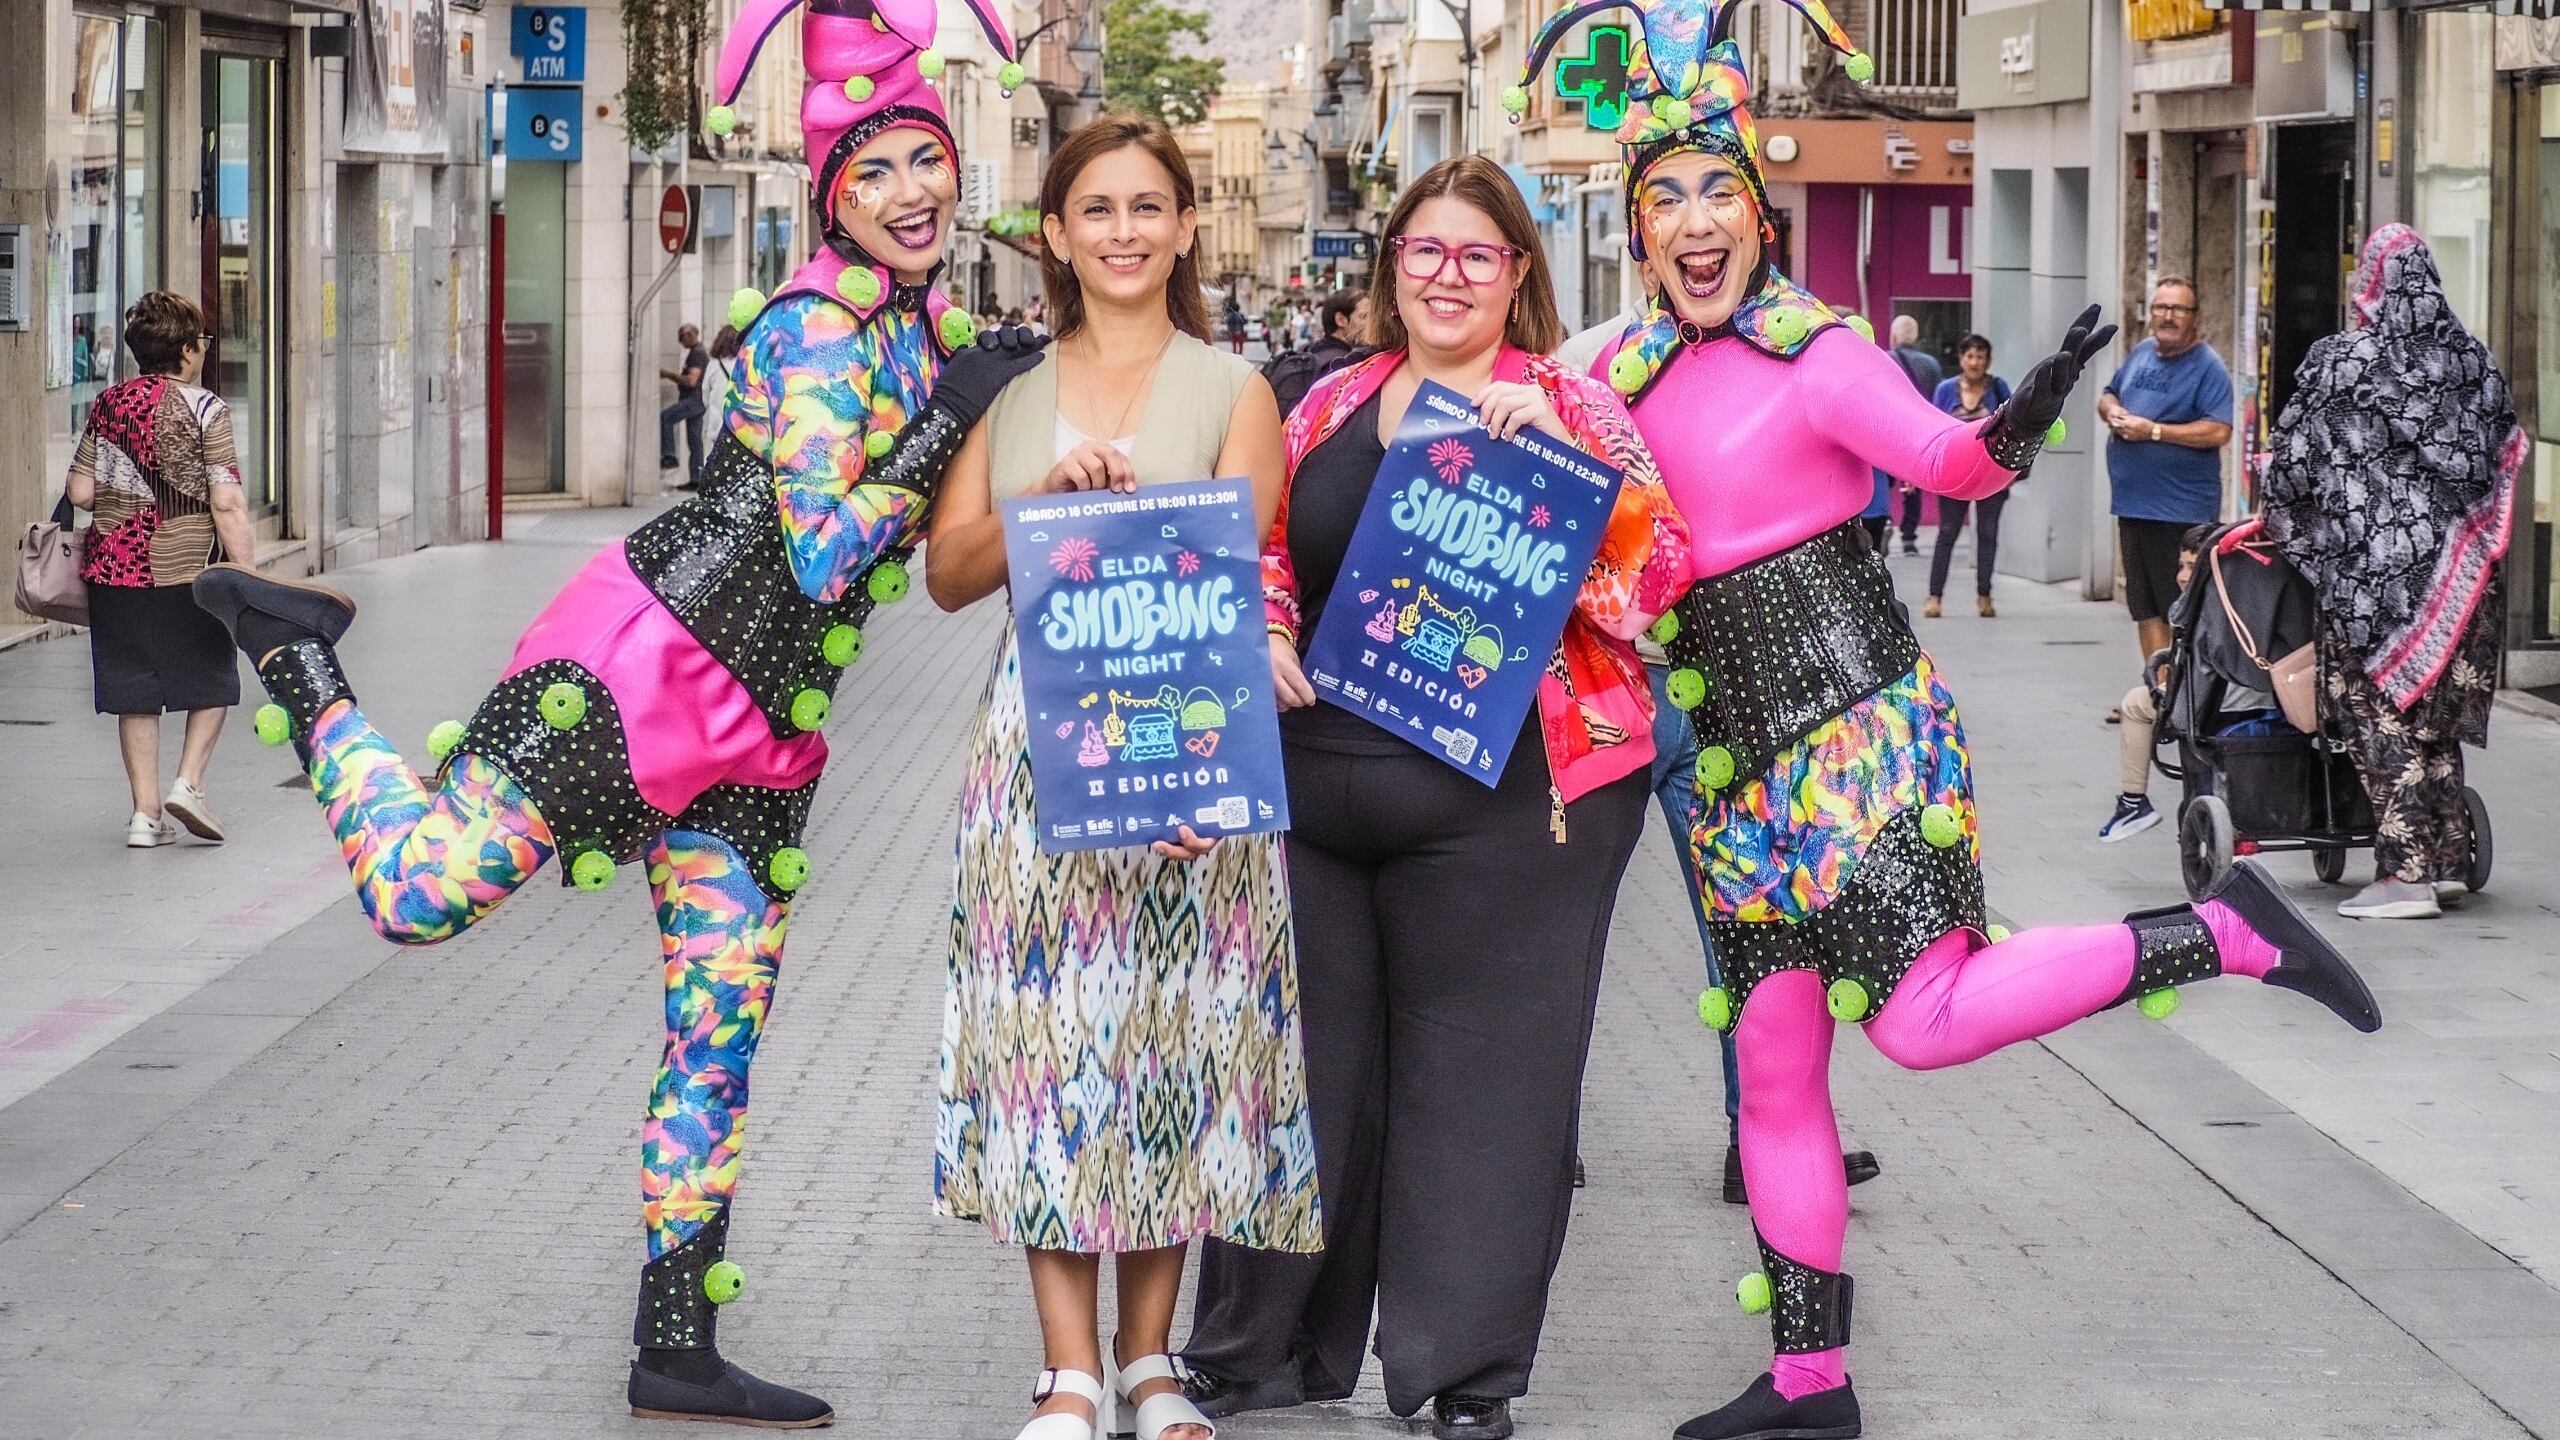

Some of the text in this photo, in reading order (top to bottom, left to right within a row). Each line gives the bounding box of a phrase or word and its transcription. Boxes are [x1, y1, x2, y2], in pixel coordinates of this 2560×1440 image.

[530, 57, 565, 78] ATM
[1426, 394, 1467, 420] SÁBADO
[1466, 412, 1479, 426] 18
[1526, 440, 1541, 456] DE
[1566, 460, 1575, 473] A
[1574, 465, 1610, 490] 22:30H
[1018, 507, 1067, 523] SÁBADO
[1067, 505, 1081, 518] 18
[1082, 499, 1138, 516] OCTUBRE
[1140, 497, 1156, 511] DE
[1188, 494, 1197, 507] A
[1198, 490, 1238, 506] 22:30H
[1466, 473, 1524, 514] ELDA
[1391, 478, 1566, 596] SHOPPING
[1101, 554, 1168, 578] ELDA
[1425, 556, 1498, 603] NIGHT
[1044, 575, 1237, 651] SHOPPING
[1103, 651, 1186, 678] NIGHT
